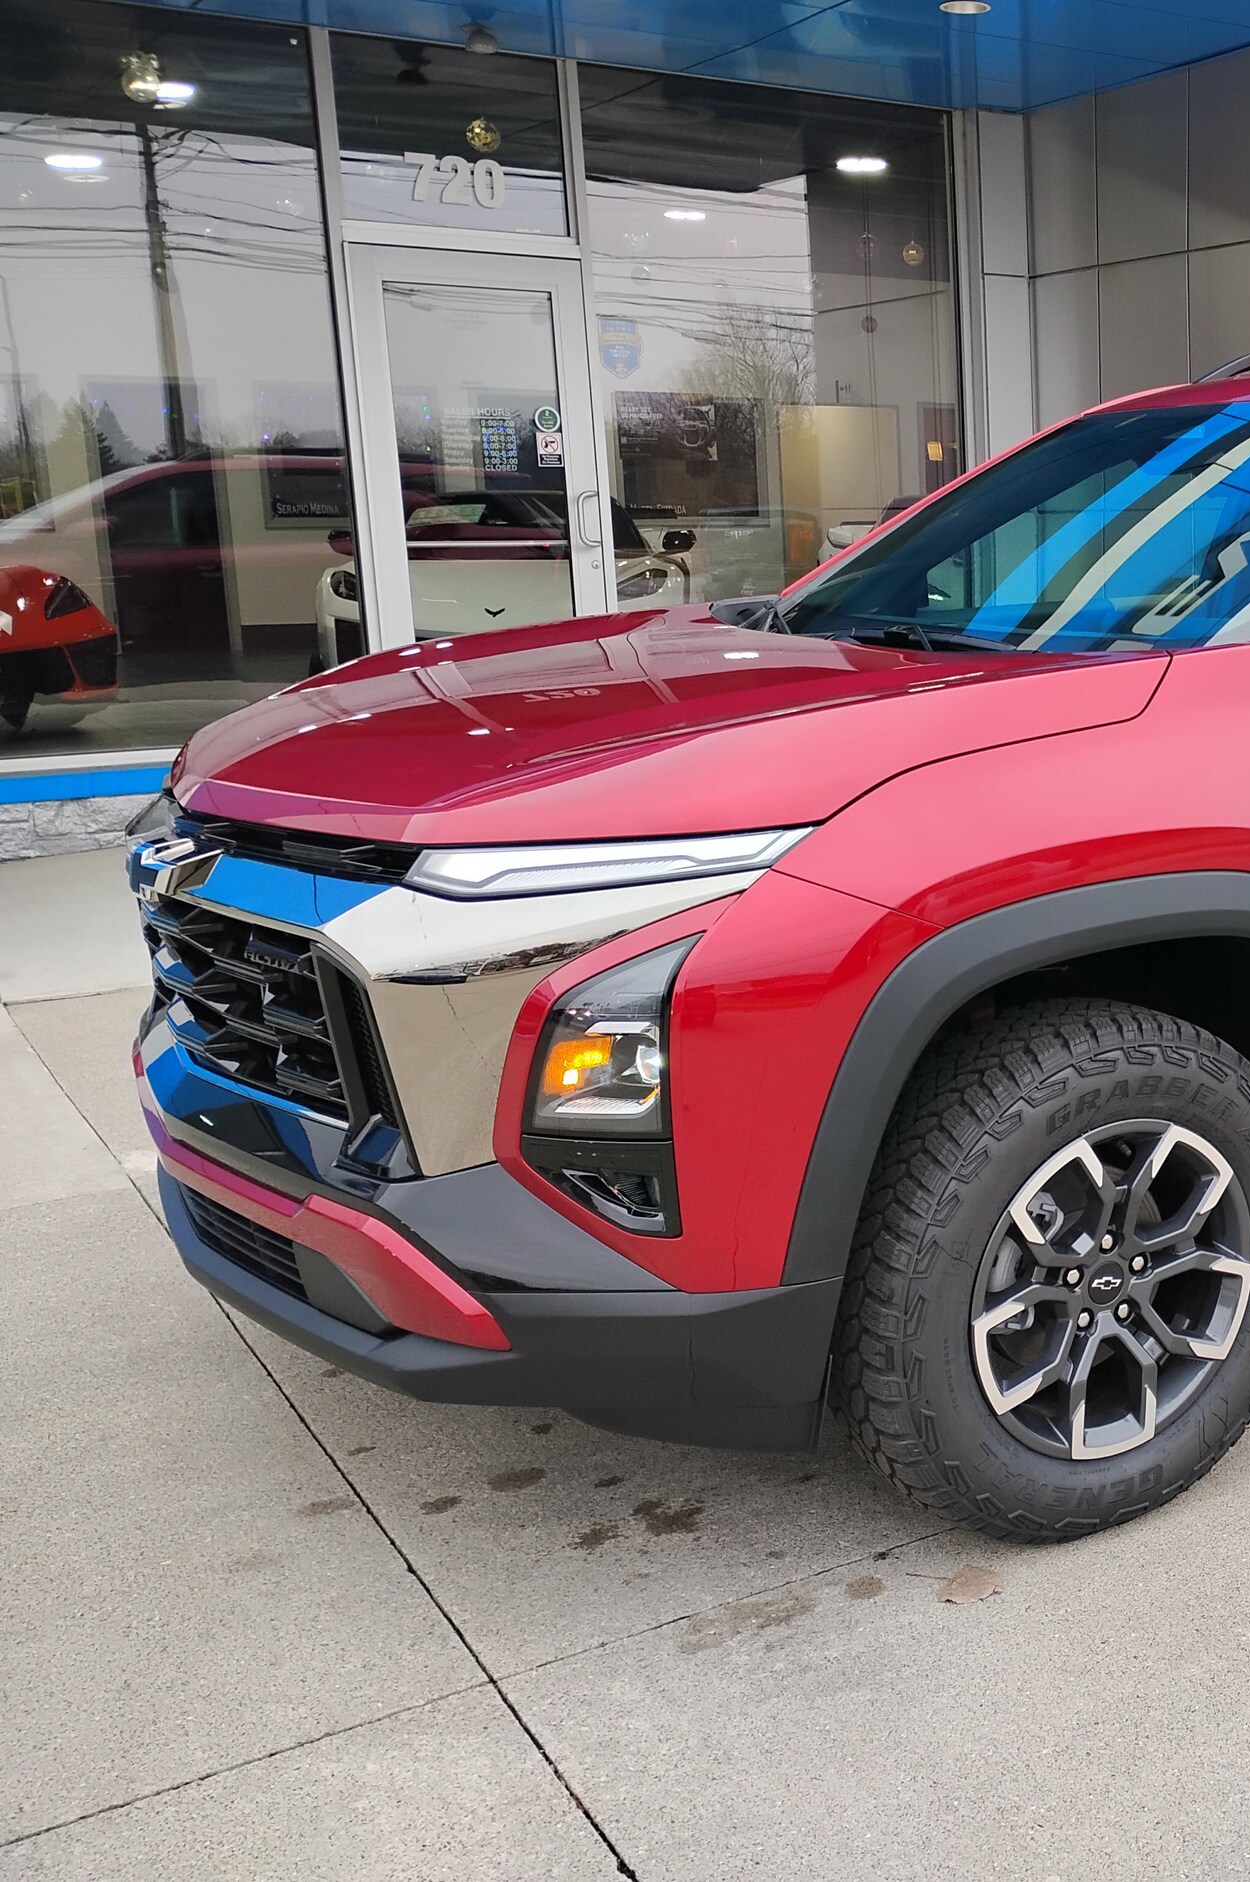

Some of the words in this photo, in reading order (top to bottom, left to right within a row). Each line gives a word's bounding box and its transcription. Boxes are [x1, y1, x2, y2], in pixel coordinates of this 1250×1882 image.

[404, 152, 506, 209] 720
[443, 407, 474, 417] SALES
[477, 407, 512, 417] HOURS
[485, 464, 518, 472] CLOSED
[276, 502, 309, 514] SERAPIO
[310, 502, 340, 514] MEDINA
[1046, 1075, 1241, 1137] GRABBER
[974, 1441, 1164, 1512] GENERAL
